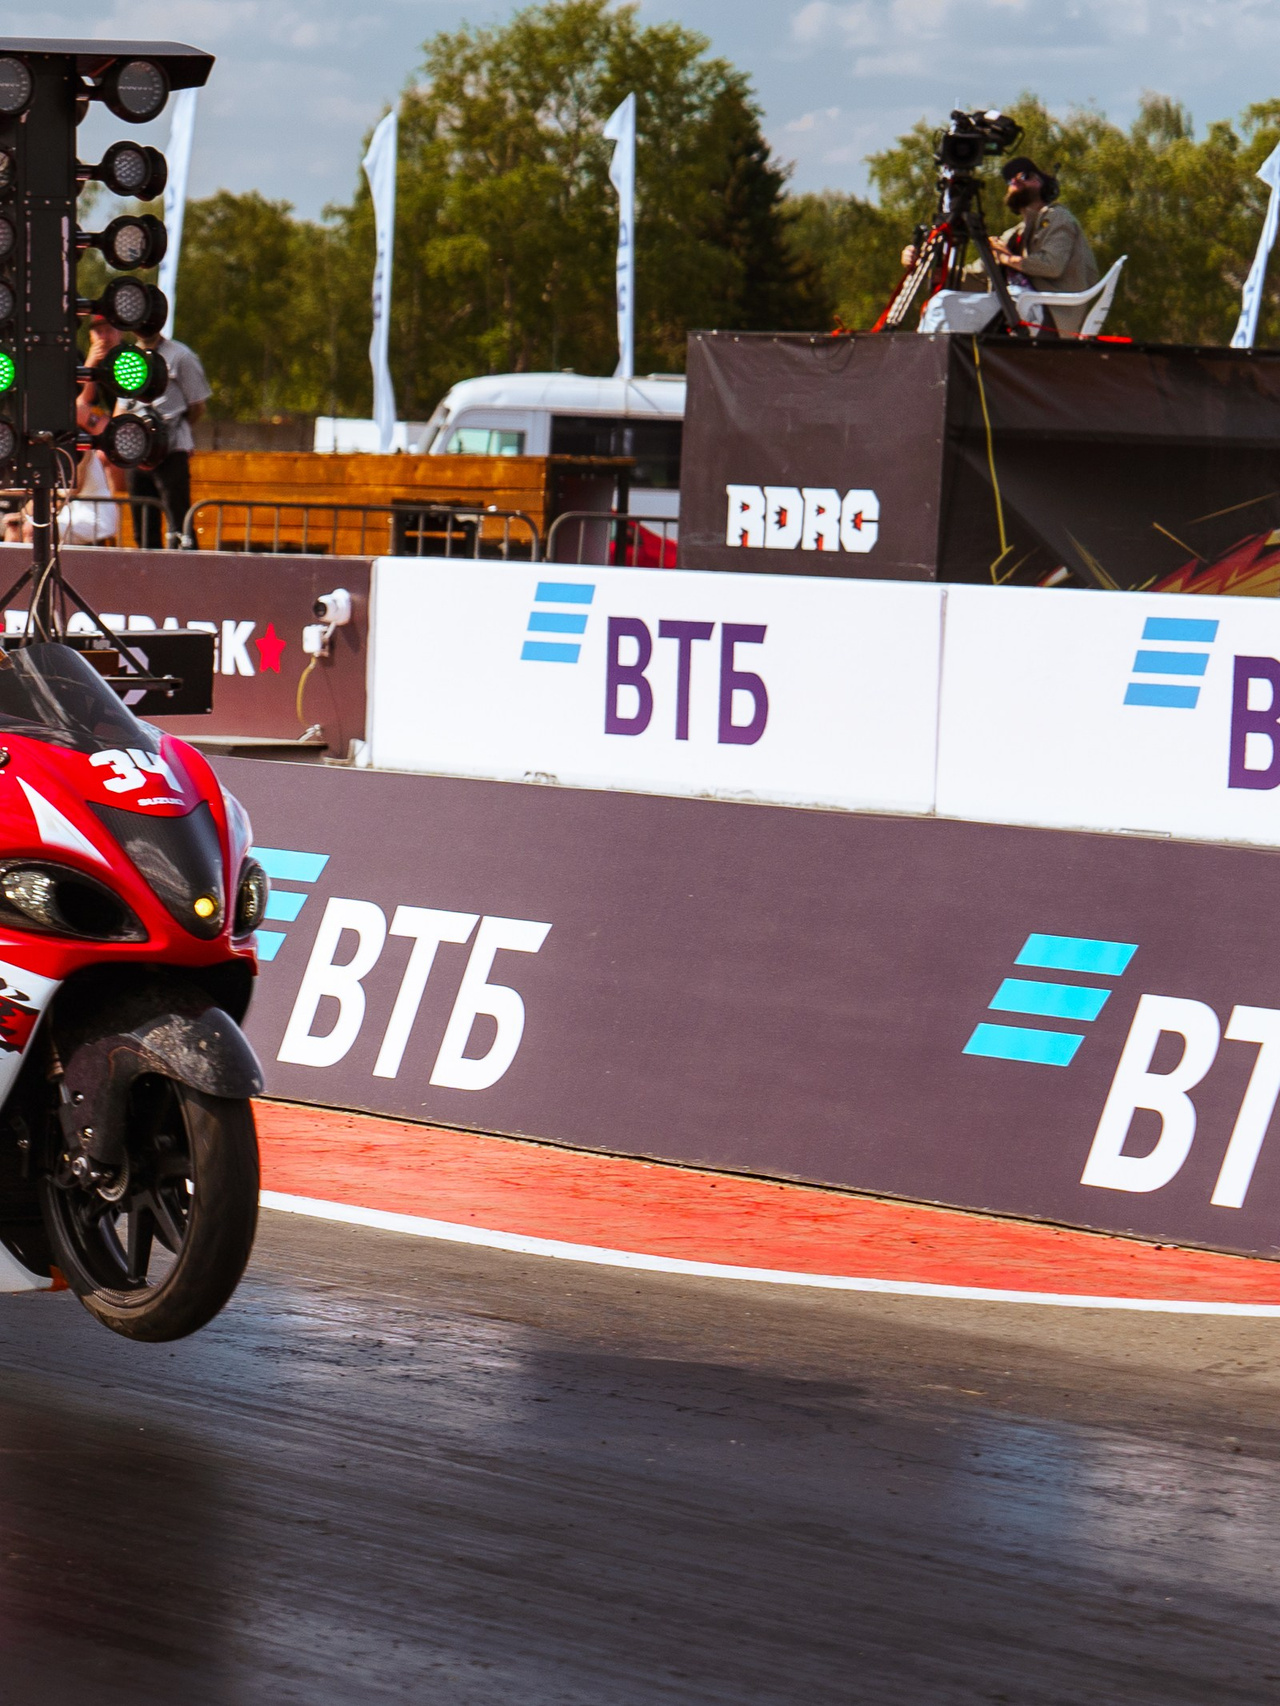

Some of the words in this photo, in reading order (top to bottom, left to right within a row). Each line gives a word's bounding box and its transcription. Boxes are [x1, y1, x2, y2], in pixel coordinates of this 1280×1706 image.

[726, 484, 880, 553] RDRC
[604, 616, 768, 745] ВТБ
[88, 748, 184, 793] 34
[276, 897, 553, 1091] ВТБ
[1080, 993, 1280, 1209] ВТ
